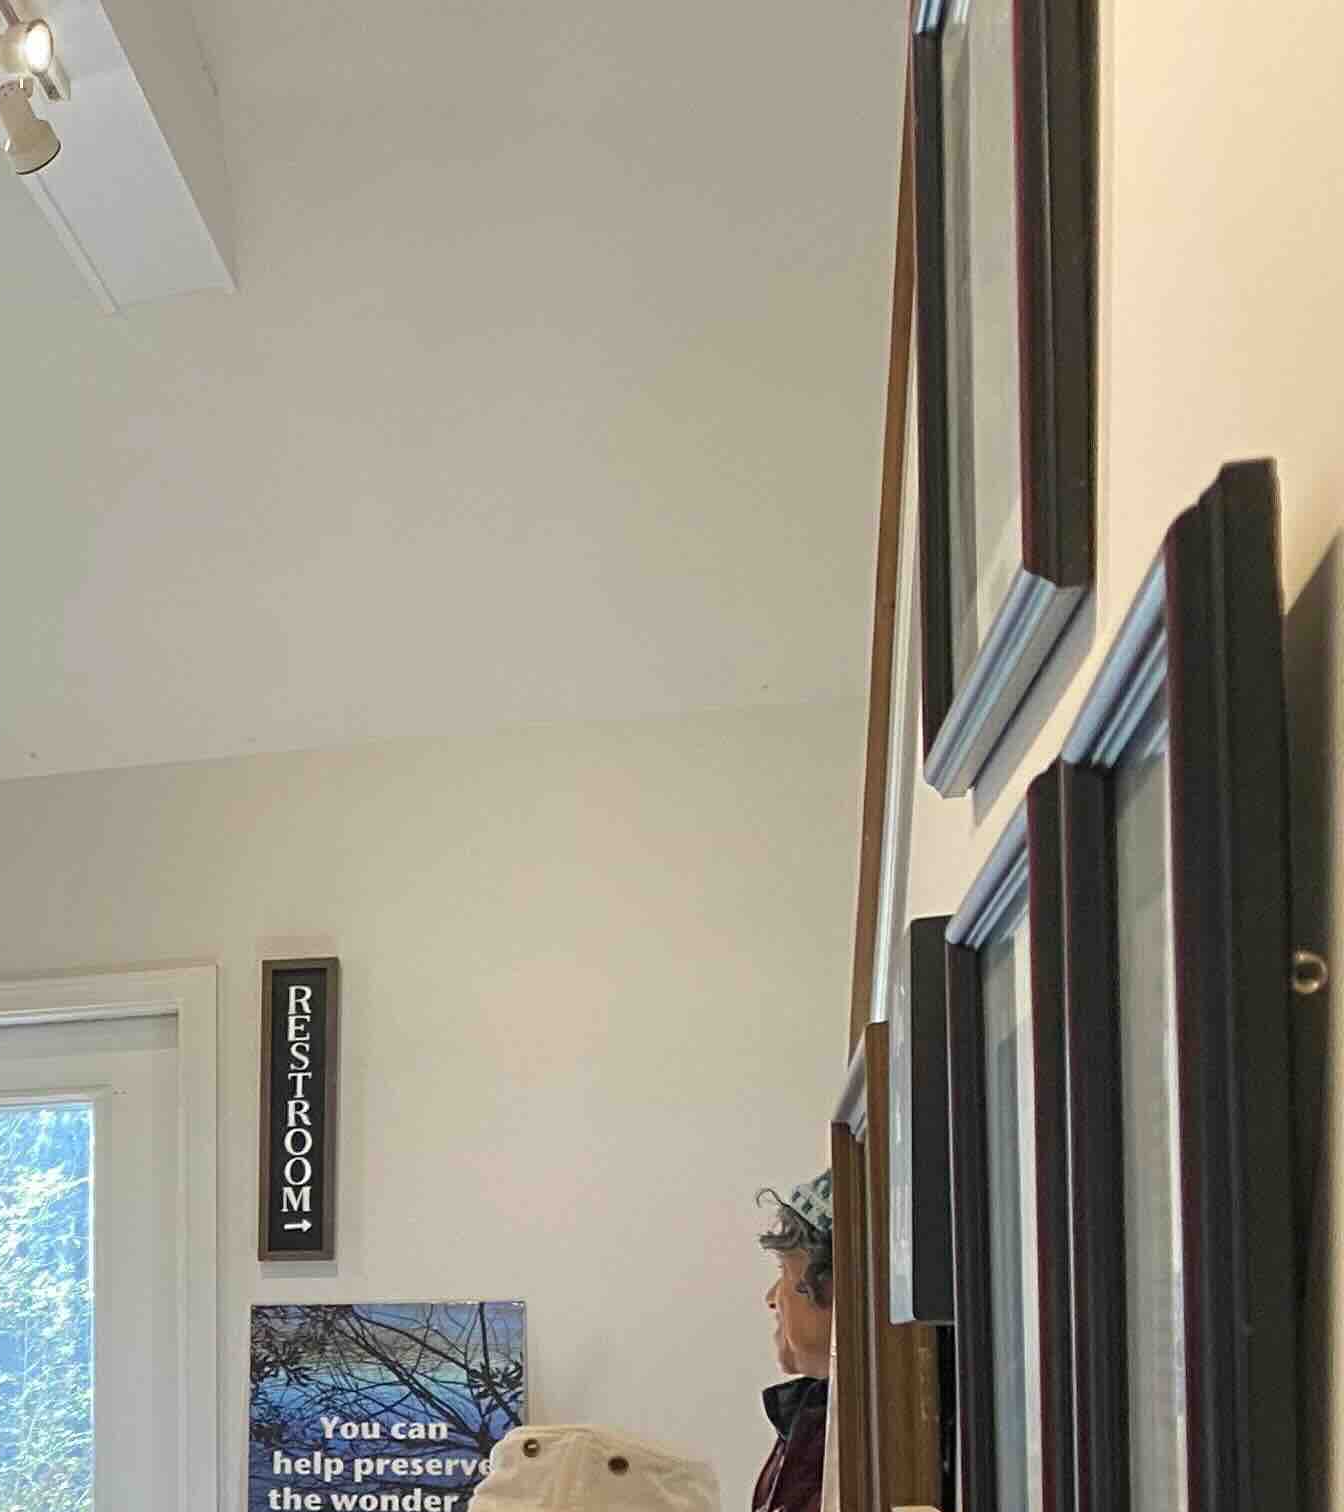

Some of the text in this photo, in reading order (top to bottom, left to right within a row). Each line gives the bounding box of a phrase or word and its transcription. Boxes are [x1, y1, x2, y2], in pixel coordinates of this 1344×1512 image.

[280, 985, 313, 1212] RESTROOM
[320, 1417, 448, 1440] You can
[272, 1451, 493, 1482] help preserve
[267, 1488, 460, 1512] the wonder
